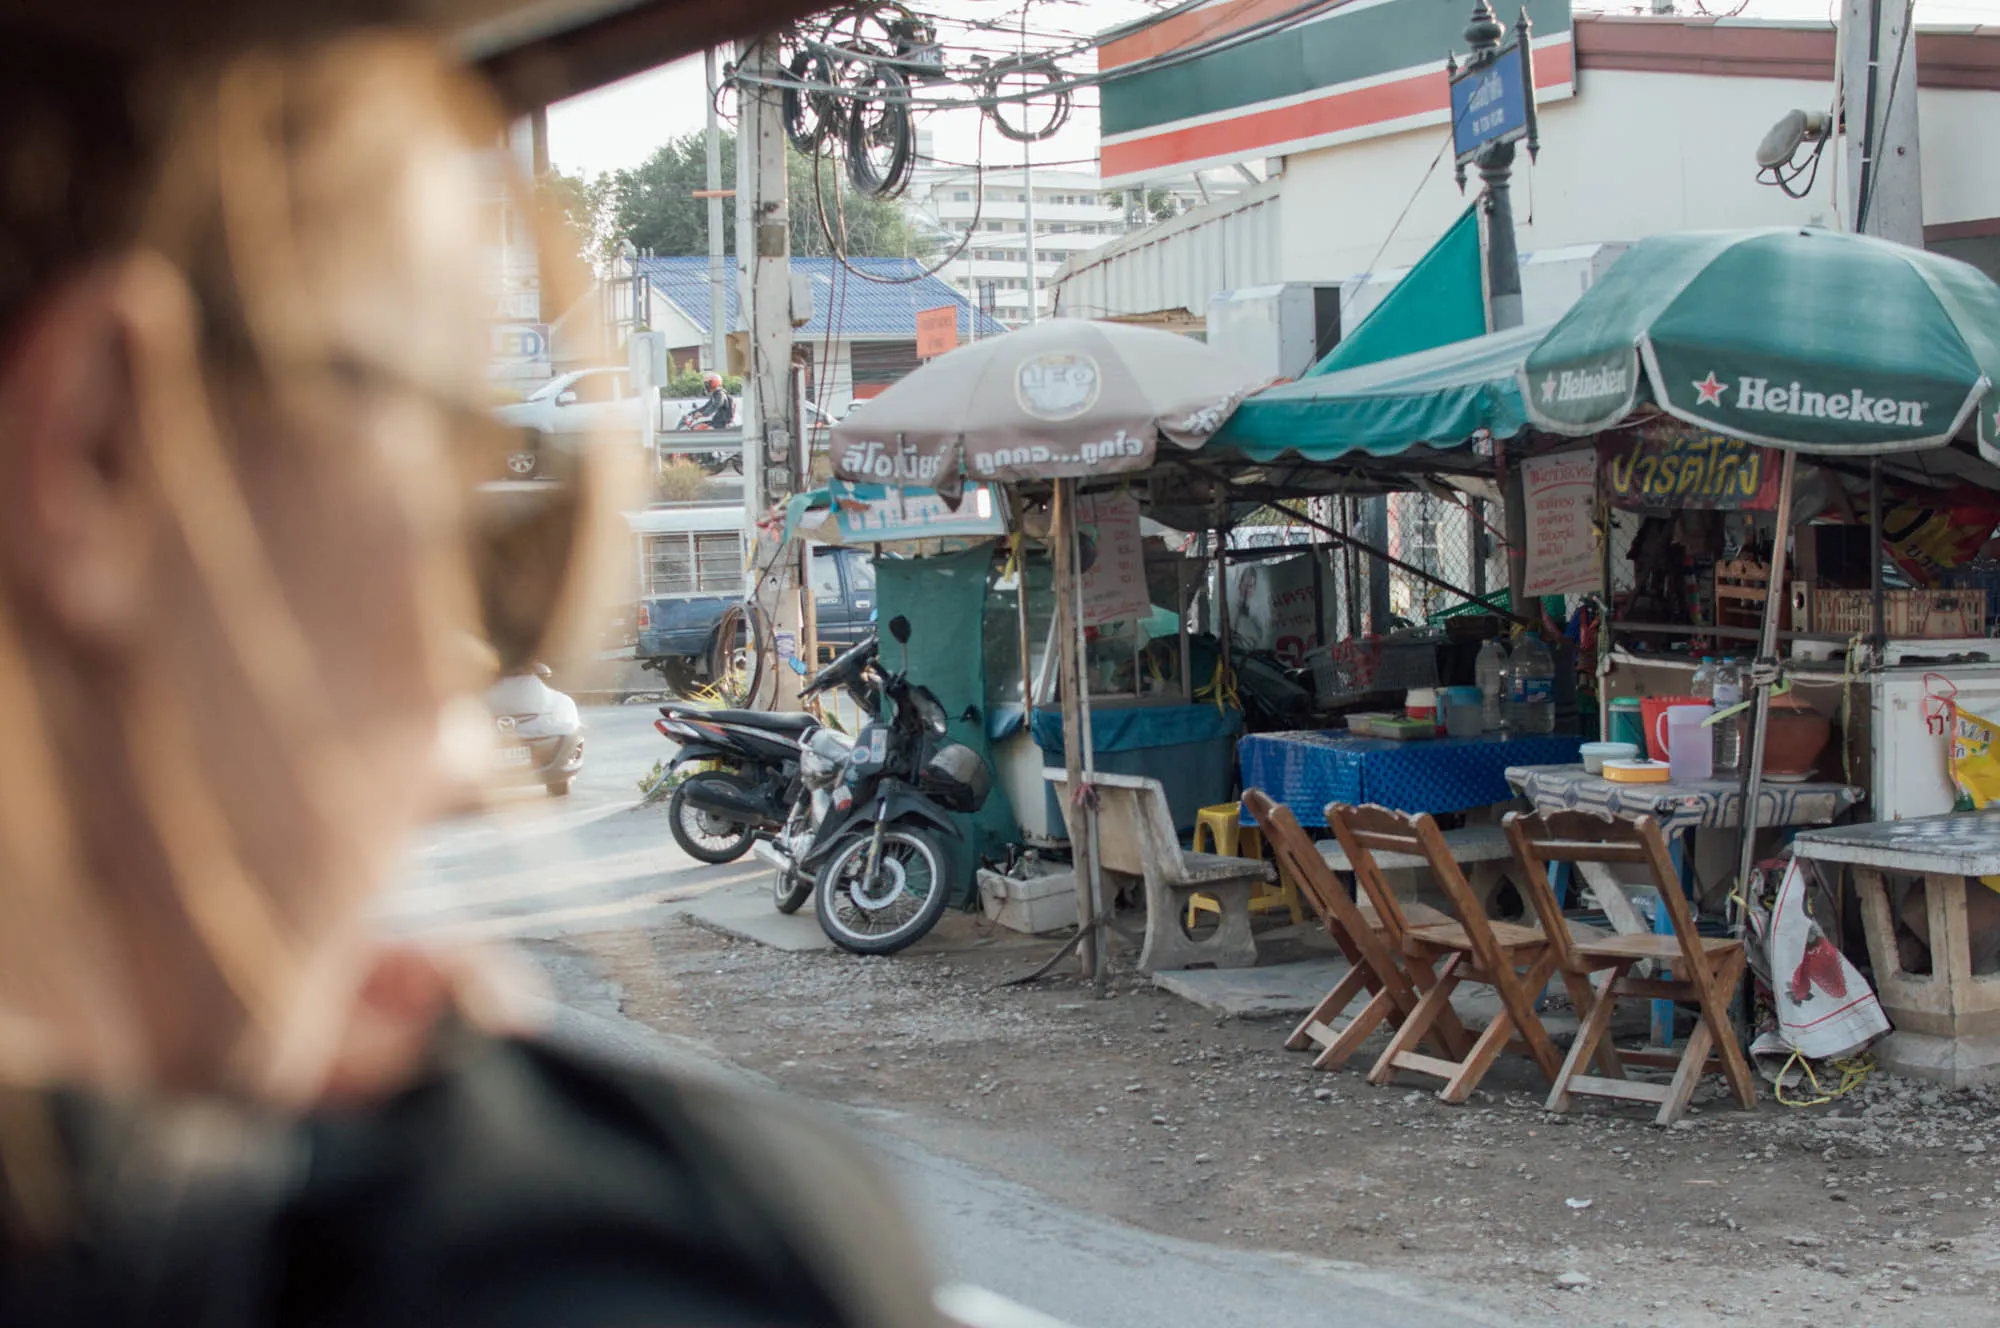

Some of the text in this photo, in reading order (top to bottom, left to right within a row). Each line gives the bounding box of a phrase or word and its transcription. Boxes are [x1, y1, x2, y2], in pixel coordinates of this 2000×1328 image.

[1021, 363, 1095, 388] LEO
[1557, 365, 1627, 401] Heineken
[1735, 376, 1924, 427] Heineken
